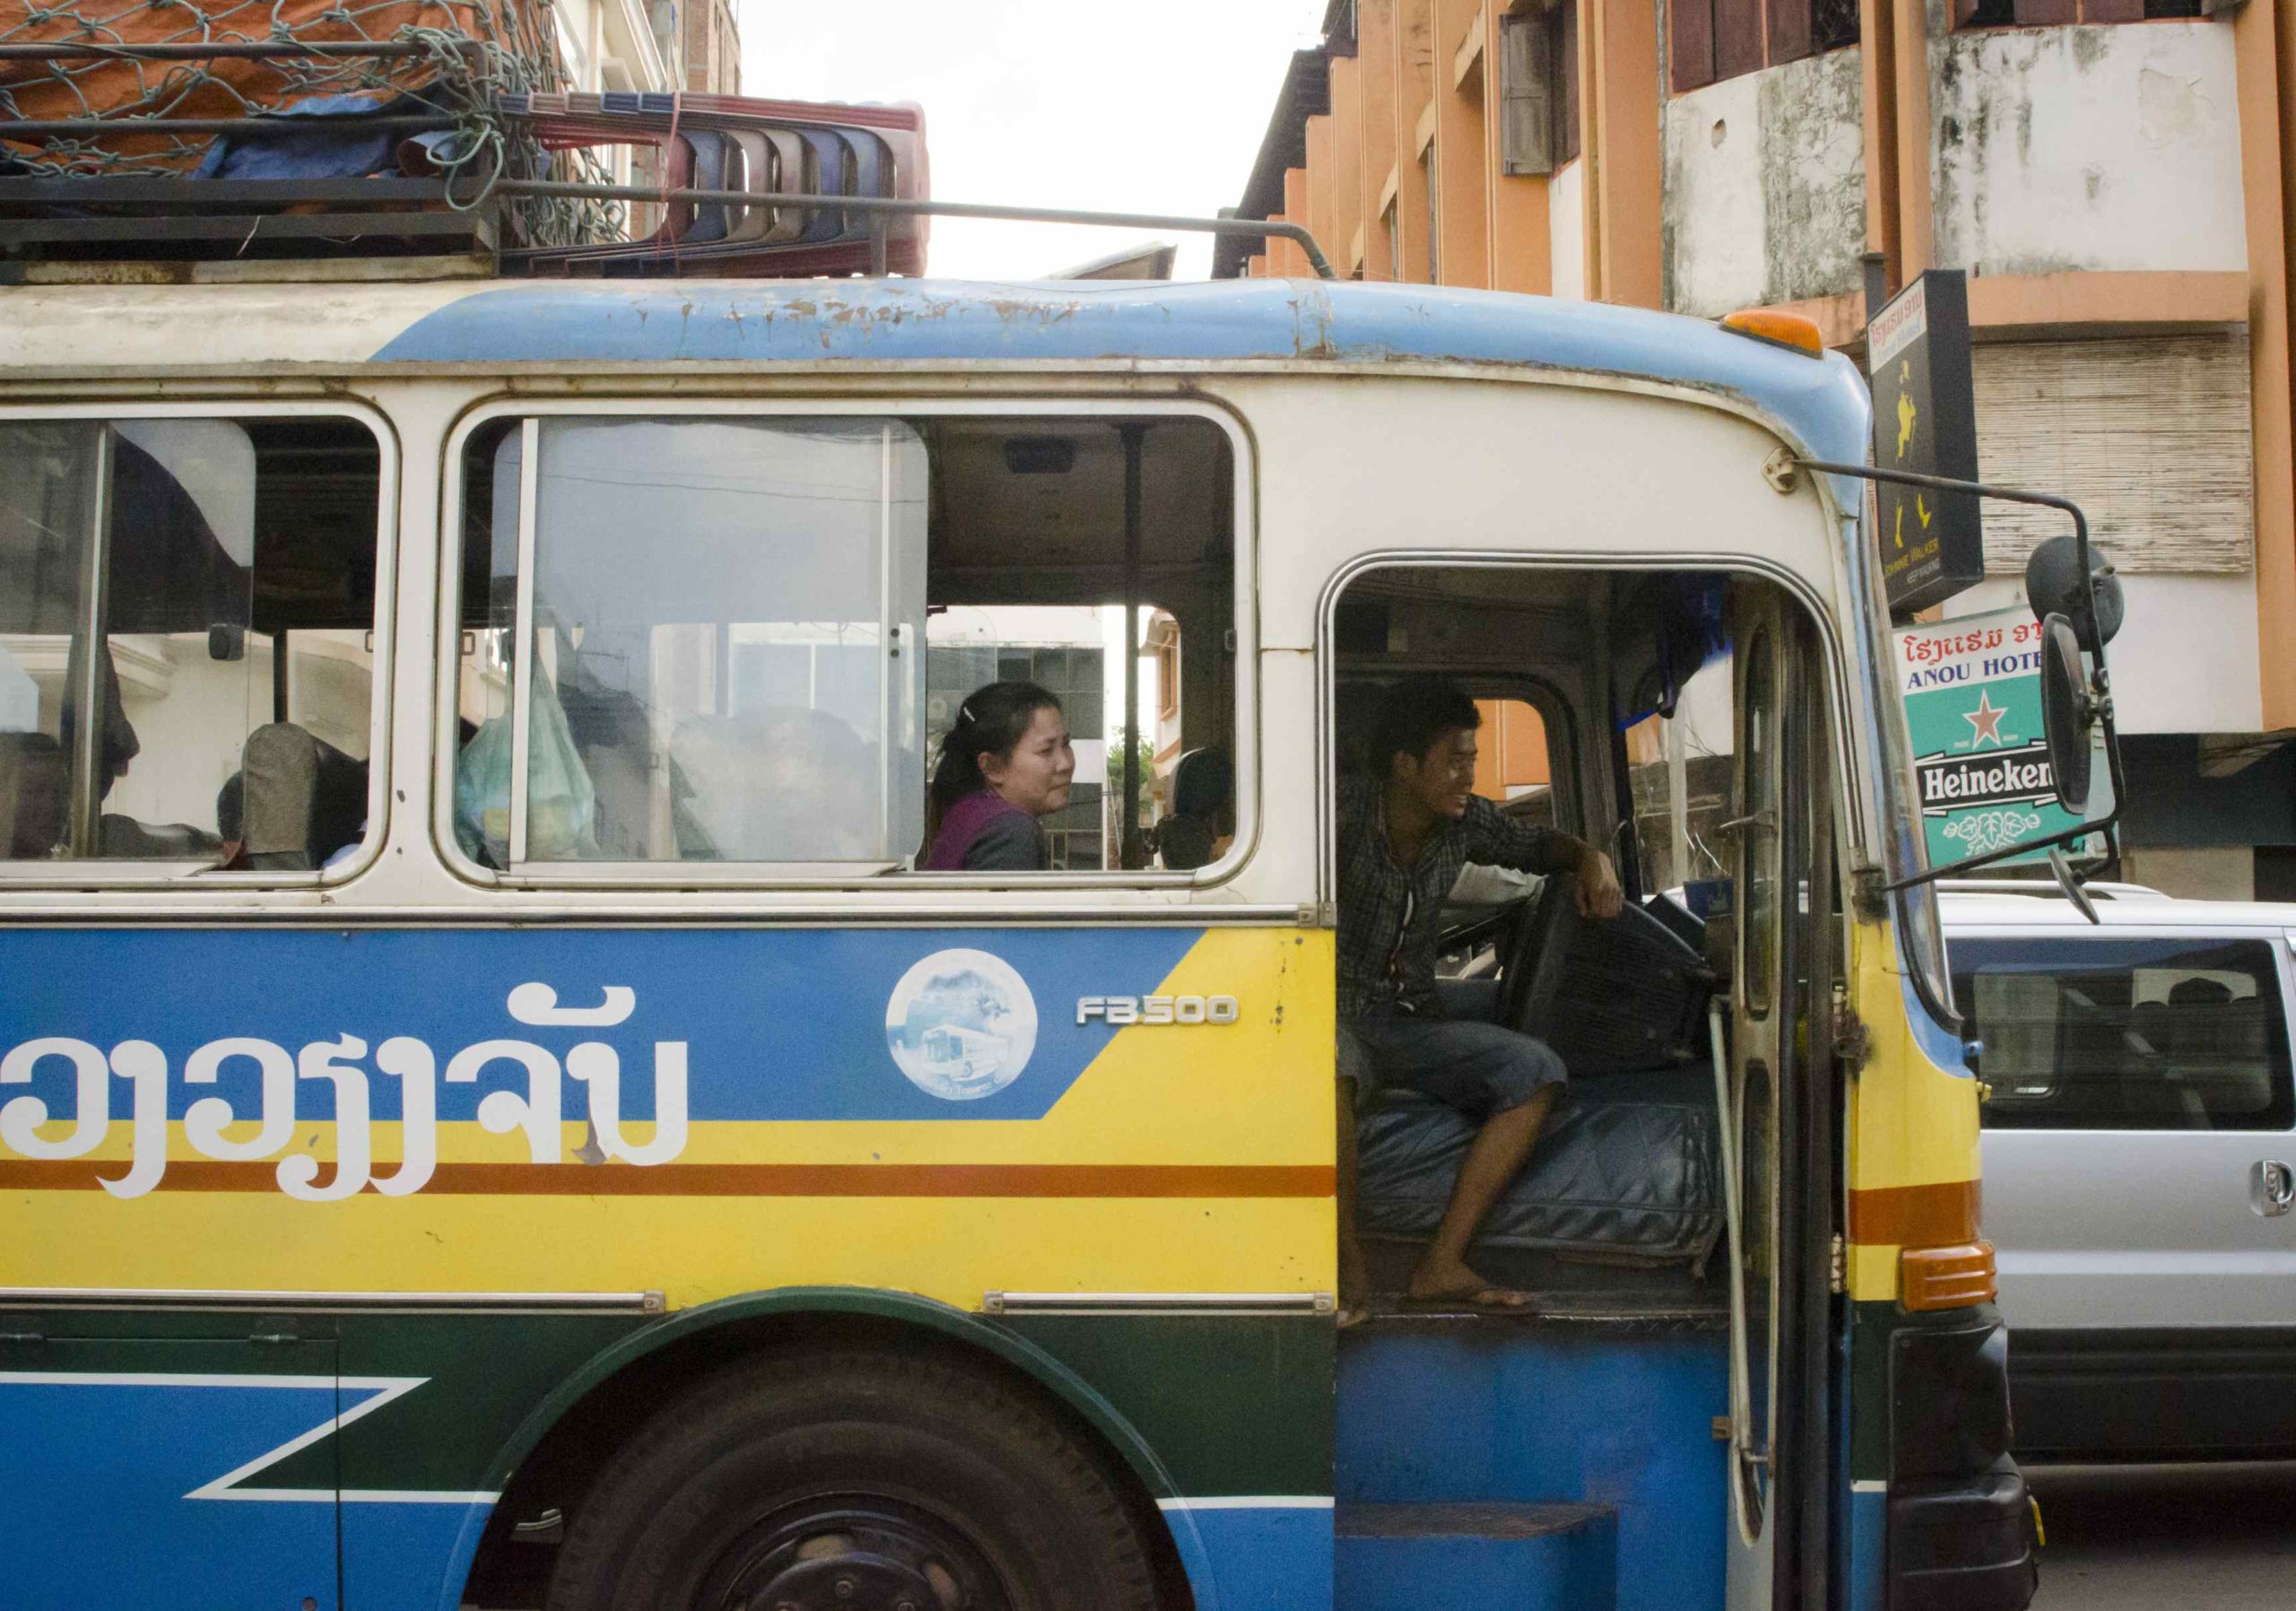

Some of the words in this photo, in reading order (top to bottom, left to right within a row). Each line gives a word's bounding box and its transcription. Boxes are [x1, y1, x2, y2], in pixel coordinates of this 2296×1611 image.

[2013, 622, 2043, 643] ອາ
[1907, 662, 1970, 690] ANOU
[1983, 650, 2042, 676] HOTE
[1924, 759, 2054, 801] Heineken
